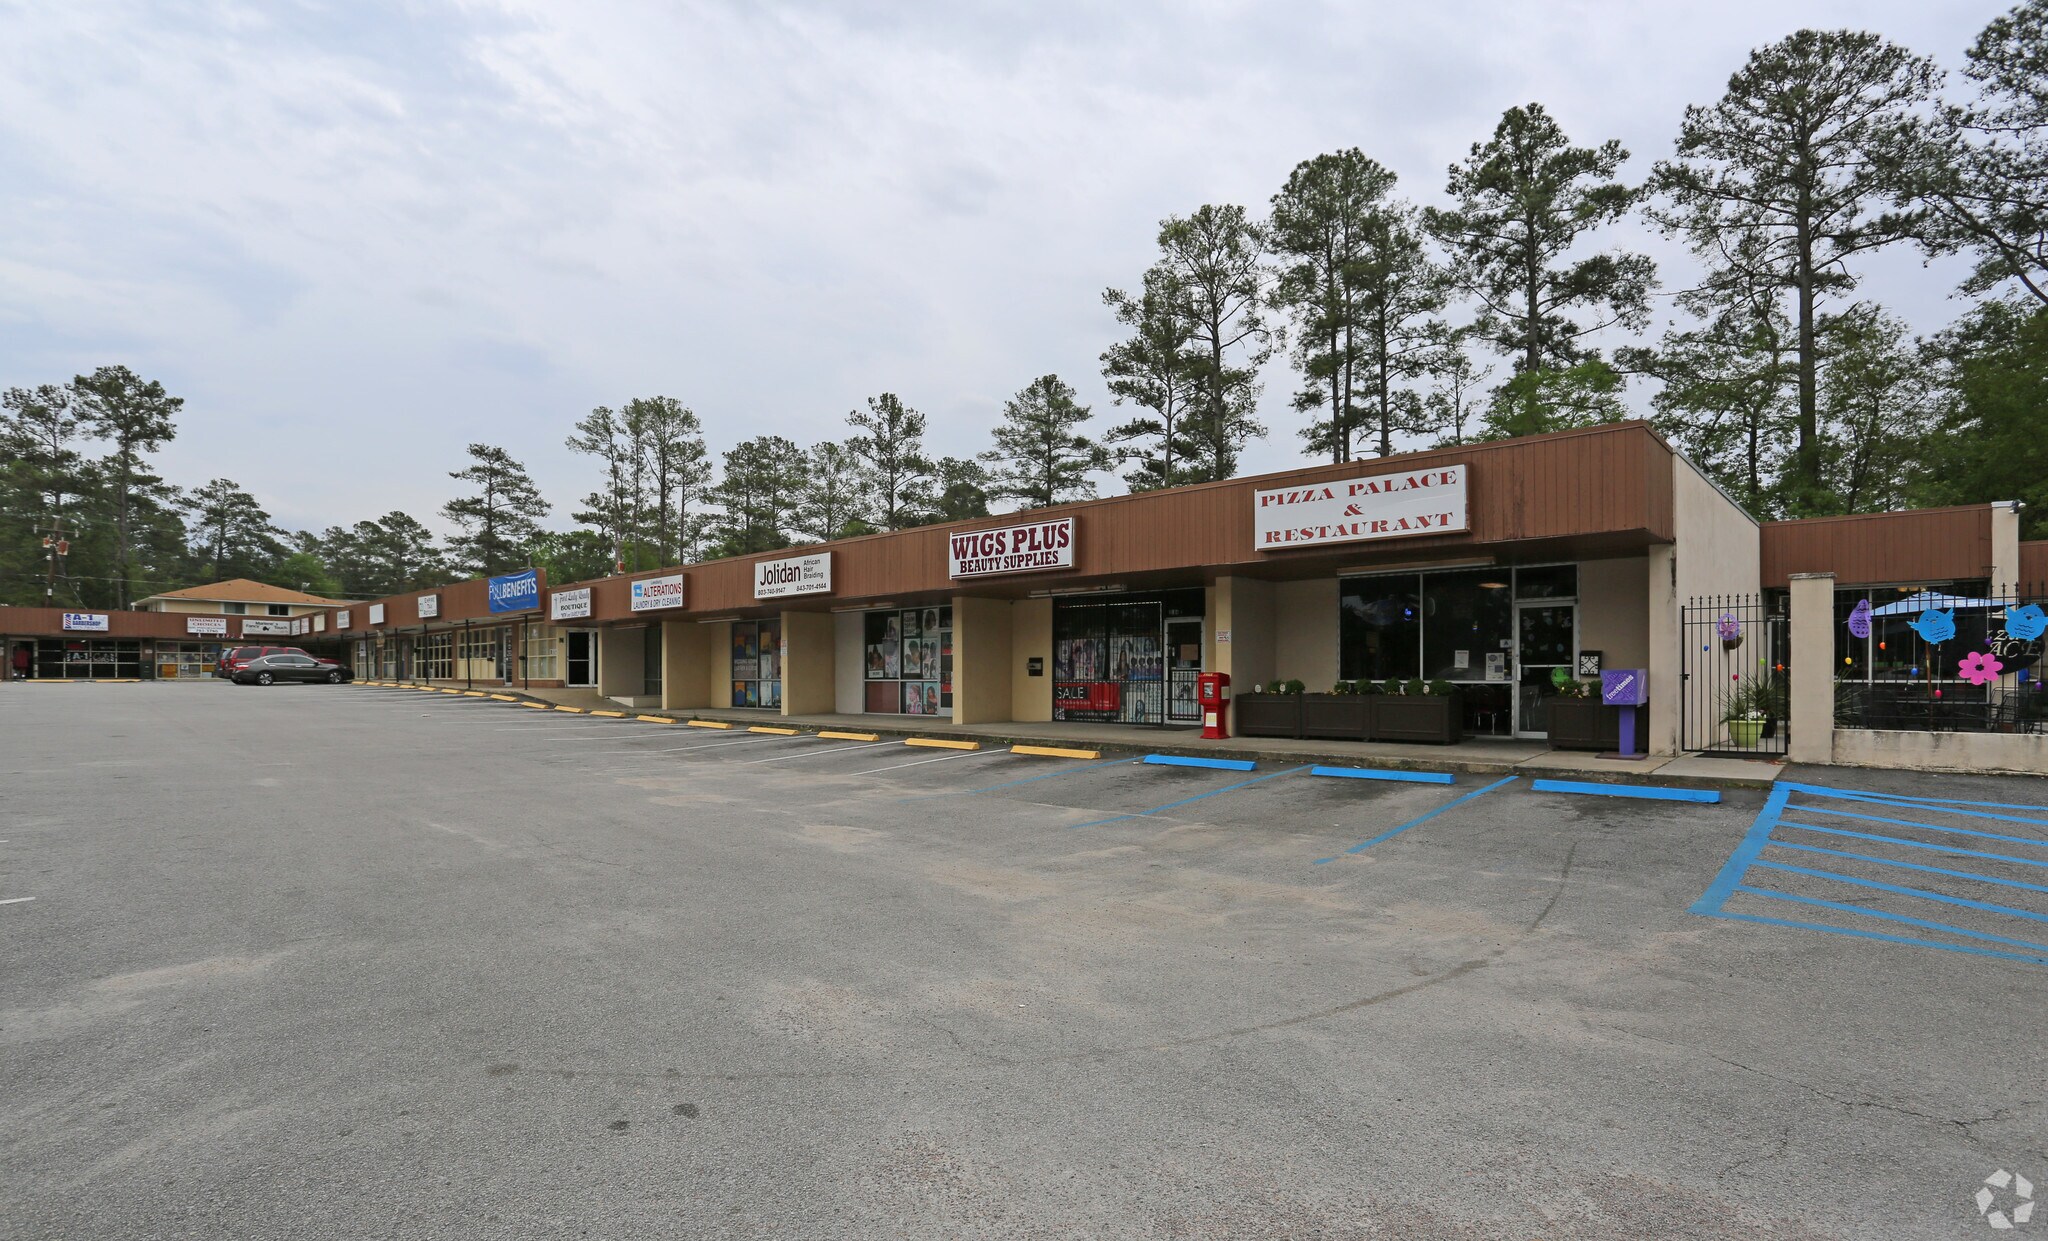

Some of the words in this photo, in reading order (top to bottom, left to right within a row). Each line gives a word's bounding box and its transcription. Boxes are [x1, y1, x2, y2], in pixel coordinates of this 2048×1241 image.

[1261, 488, 1335, 507] PIZZA
[1348, 470, 1457, 497] PALACE
[1343, 503, 1365, 517] &
[1265, 512, 1454, 543] RESTAURANT
[952, 531, 1006, 560] WIGS
[1012, 523, 1070, 553] PLUS
[960, 557, 1002, 573] BEAUTY
[1003, 550, 1059, 569] SUPPLIES
[760, 562, 801, 586] Jolidan
[803, 572, 824, 580] Braiding
[643, 582, 682, 598] ALTERATIONS
[662, 596, 681, 607] CLEANING
[72, 652, 89, 660] A-1
[1057, 686, 1084, 699] SALE
